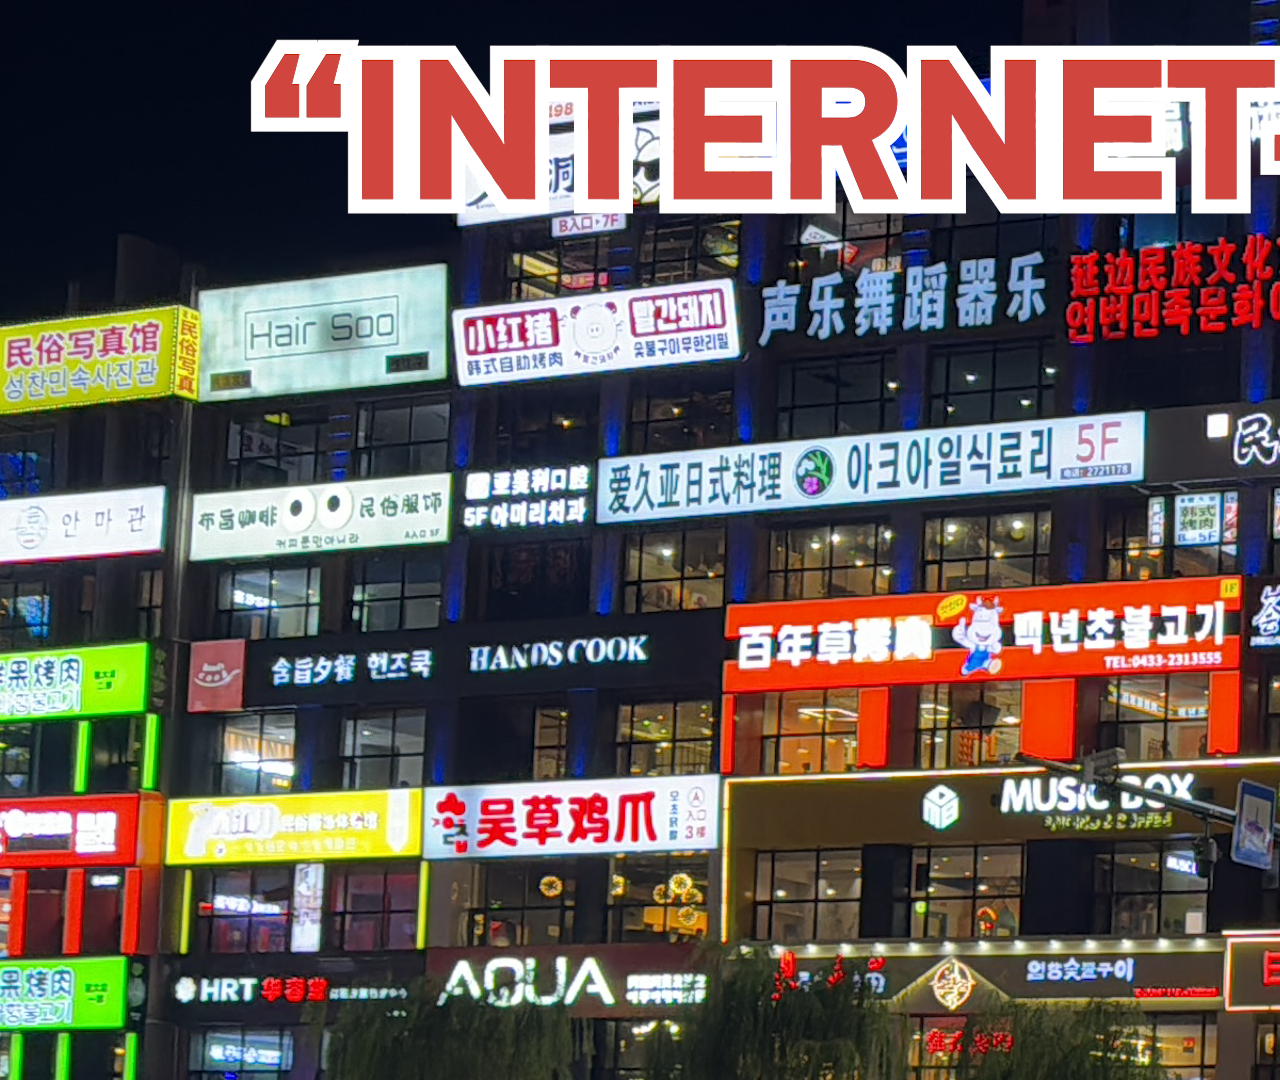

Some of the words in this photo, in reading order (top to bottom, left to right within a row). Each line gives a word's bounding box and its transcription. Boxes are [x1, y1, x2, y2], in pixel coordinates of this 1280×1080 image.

[758, 251, 1047, 347] 声乐舞蹈器乐
[4, 320, 162, 370] 民俗写真馆
[249, 308, 318, 351] Hair
[330, 308, 396, 343] Soo
[467, 311, 555, 354] 小红猪
[4, 358, 158, 402] 성찬민속사진관
[467, 352, 564, 377] 韩式自助烤肉
[846, 425, 1055, 496] 아크아일식료리
[1075, 420, 1123, 464] 5F
[608, 449, 784, 516] 爱久亚日式料理
[1012, 601, 1226, 657] 백년초불고기
[469, 640, 565, 673] HANDS
[568, 634, 649, 664] COOK
[476, 791, 659, 848] 吴草鸡爪
[200, 976, 261, 1003] HRT
[436, 955, 616, 1008] AQUA
